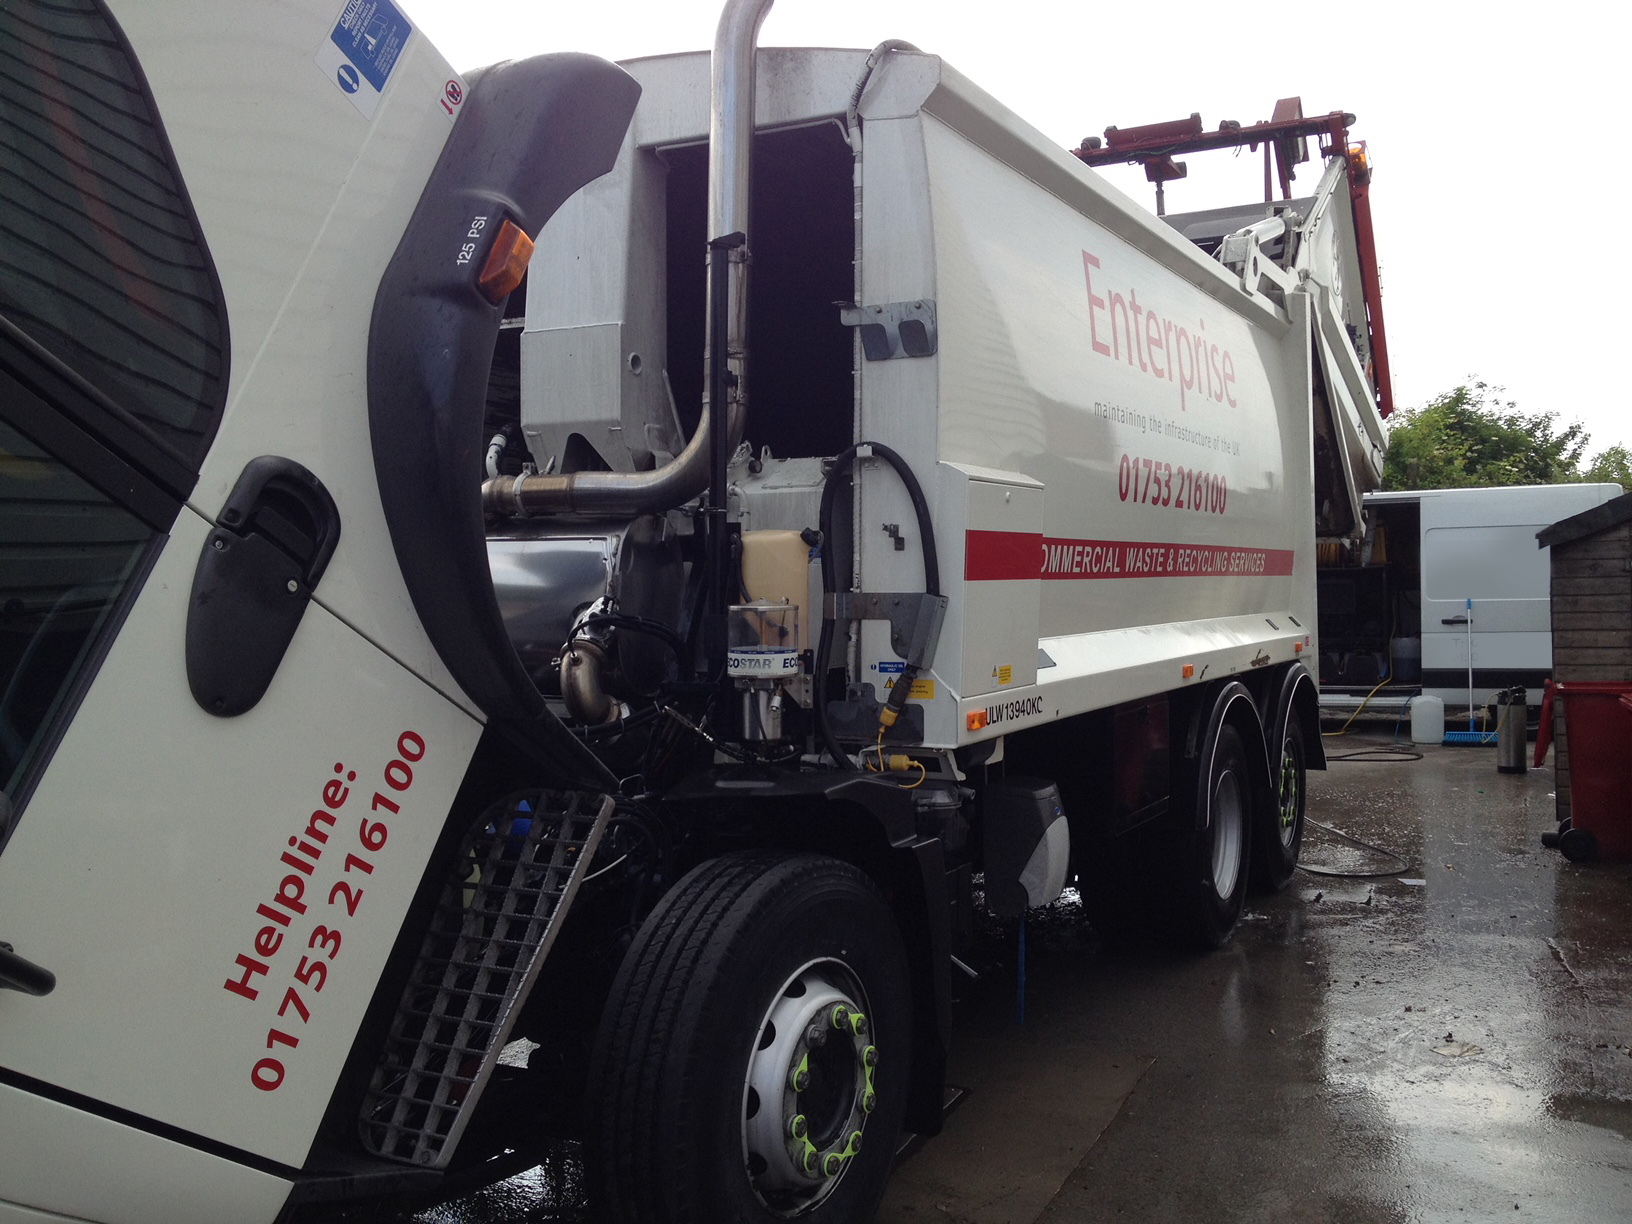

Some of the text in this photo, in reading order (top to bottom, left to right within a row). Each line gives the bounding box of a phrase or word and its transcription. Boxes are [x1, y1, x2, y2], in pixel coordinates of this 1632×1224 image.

[456, 216, 487, 265] 125 PSI
[1082, 249, 1237, 411] Enterprise
[1094, 402, 1241, 457] maintaining the infrastructure of the UK
[1118, 453, 1227, 515] 01753 216100
[1125, 548, 1165, 572] WASTE
[1167, 548, 1174, 572] &
[1176, 549, 1228, 572] RECYCLING
[1229, 552, 1266, 572] SERVICES
[223, 762, 357, 1001] Helpline:
[251, 730, 426, 1092] 01753 216100
